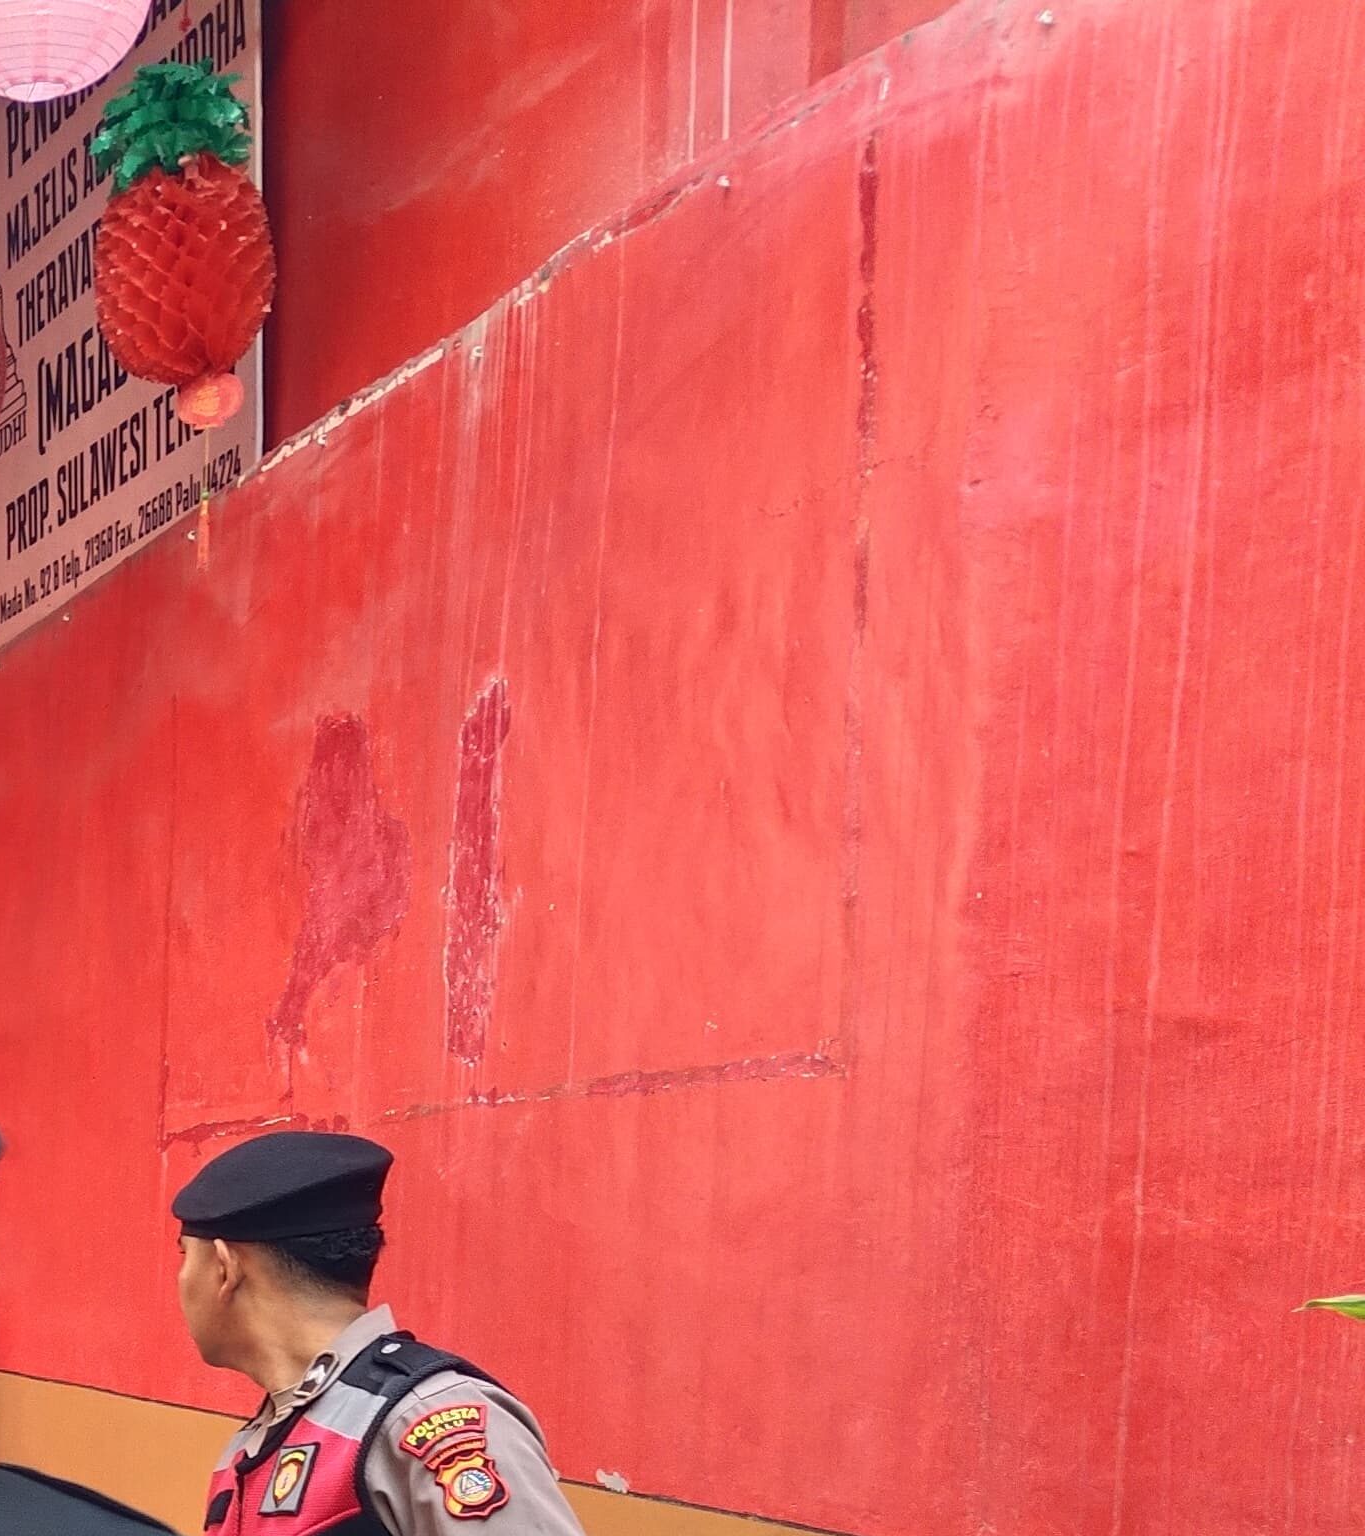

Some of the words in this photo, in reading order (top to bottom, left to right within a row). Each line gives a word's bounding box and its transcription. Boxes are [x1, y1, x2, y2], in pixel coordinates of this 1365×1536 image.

[6, 147, 77, 269] MAJELIS
[6, 477, 53, 561] PROP.
[57, 406, 147, 527] SULAWESI
[406, 1407, 480, 1447] POLRESTA
[425, 1418, 466, 1440] PALU
